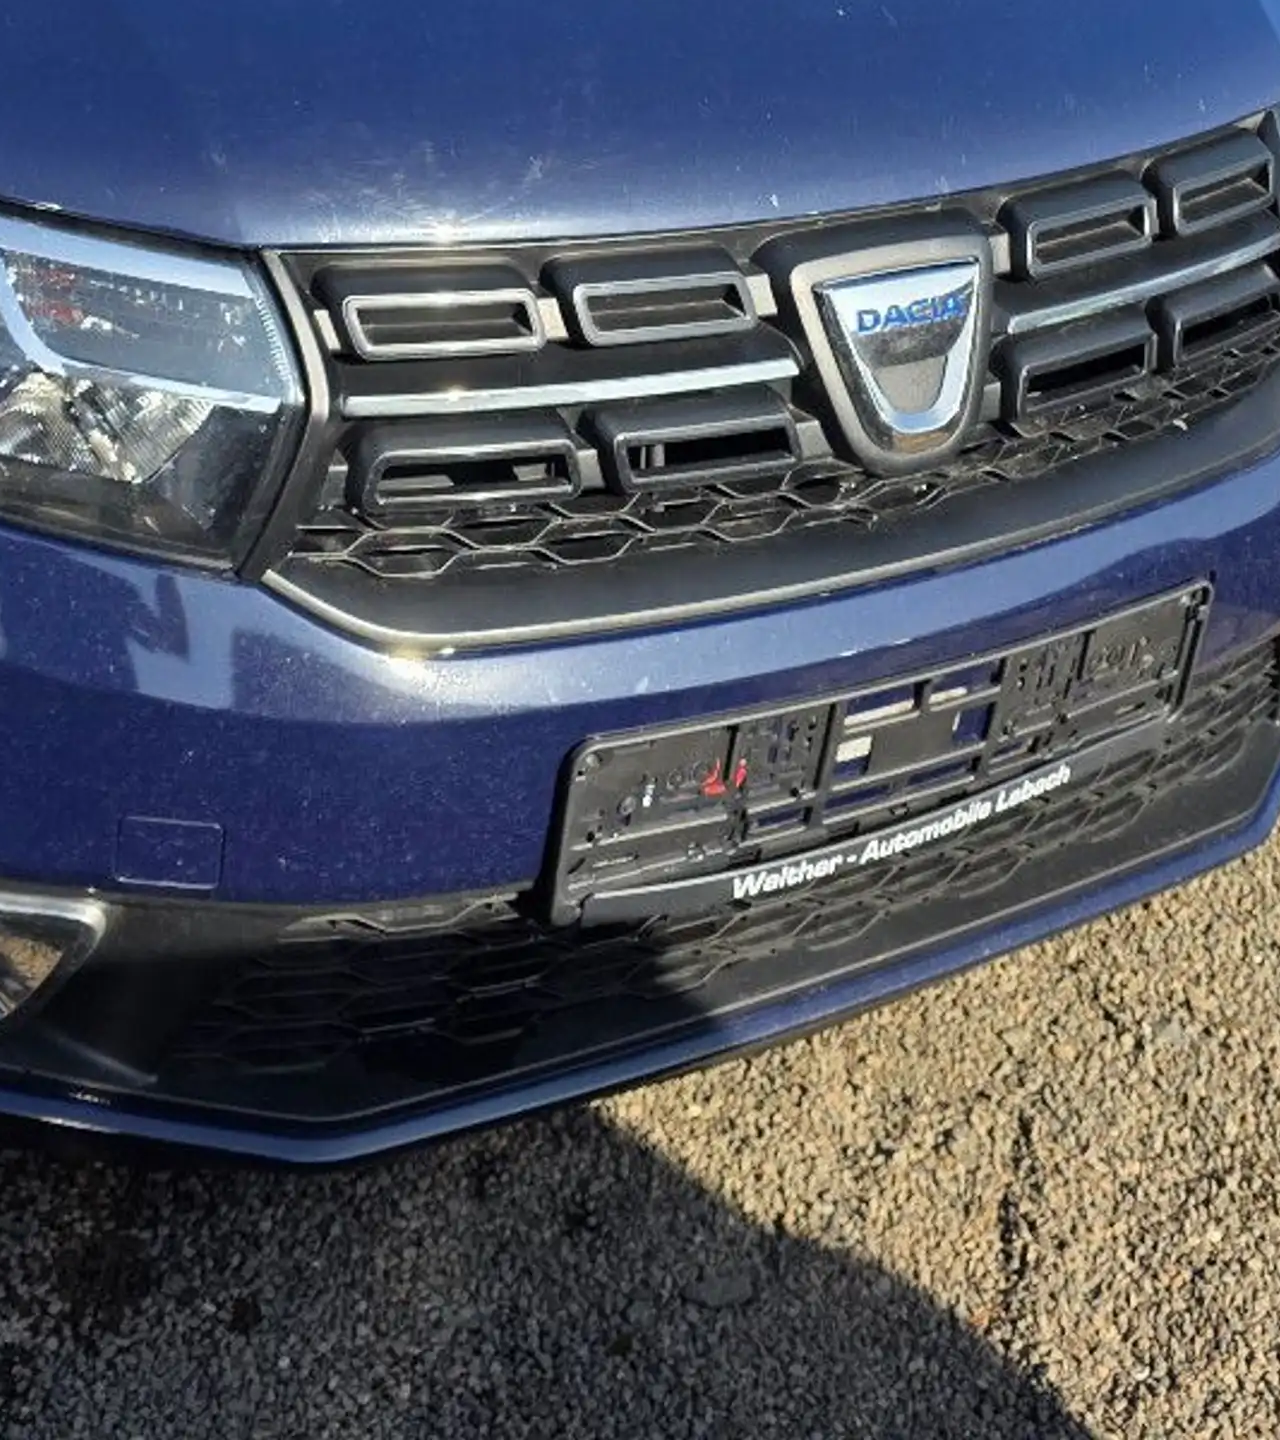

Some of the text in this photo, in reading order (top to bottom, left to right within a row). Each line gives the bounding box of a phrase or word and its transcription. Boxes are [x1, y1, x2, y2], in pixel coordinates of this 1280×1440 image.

[857, 292, 969, 332] DACIA
[732, 854, 843, 899] Walther
[859, 800, 991, 865] Automobile
